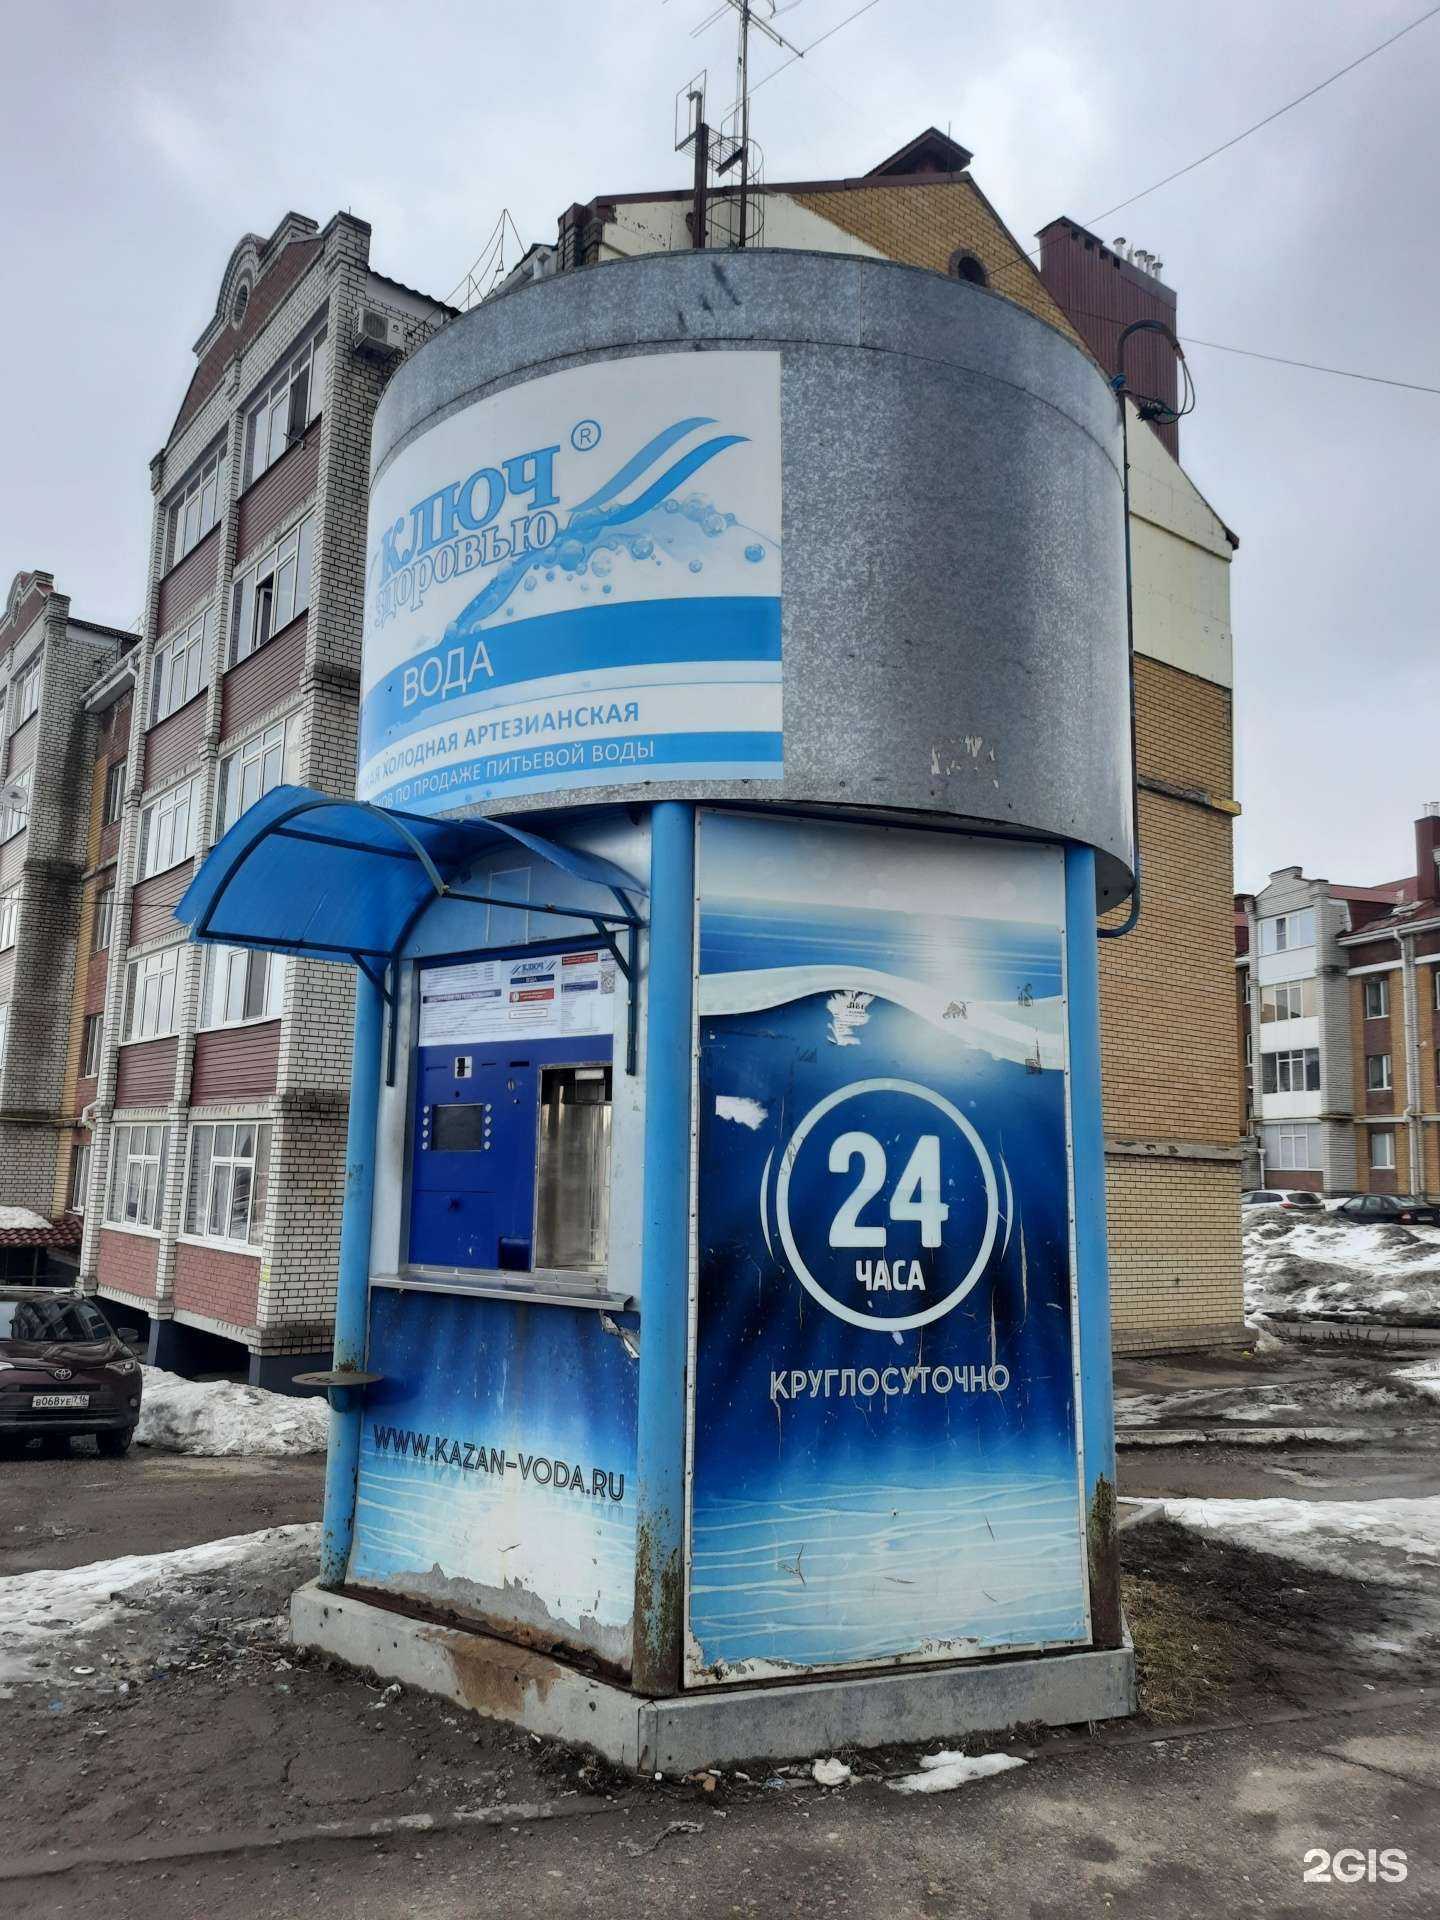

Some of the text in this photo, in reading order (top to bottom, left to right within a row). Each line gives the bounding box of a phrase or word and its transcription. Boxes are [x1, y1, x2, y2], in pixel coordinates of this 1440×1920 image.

[378, 445, 560, 586] КЛЮЧ
[403, 640, 495, 708] ВОДА
[383, 733, 458, 777] ХОЛОДНАЯ
[464, 702, 639, 750] АРТЕЗИАНСКАЯ
[414, 763, 481, 797] ПРОДАЖЕ
[486, 742, 585, 779] ПИТЬЕВОЙ
[592, 740, 655, 763] ВОДЫ
[829, 1131, 949, 1249] 24
[855, 1260, 926, 1291] ЧАСА
[770, 1364, 1010, 1400] КРУГЛОСУТОЧНО
[373, 1424, 625, 1500] WWW.KAZAN-VODA.RU
